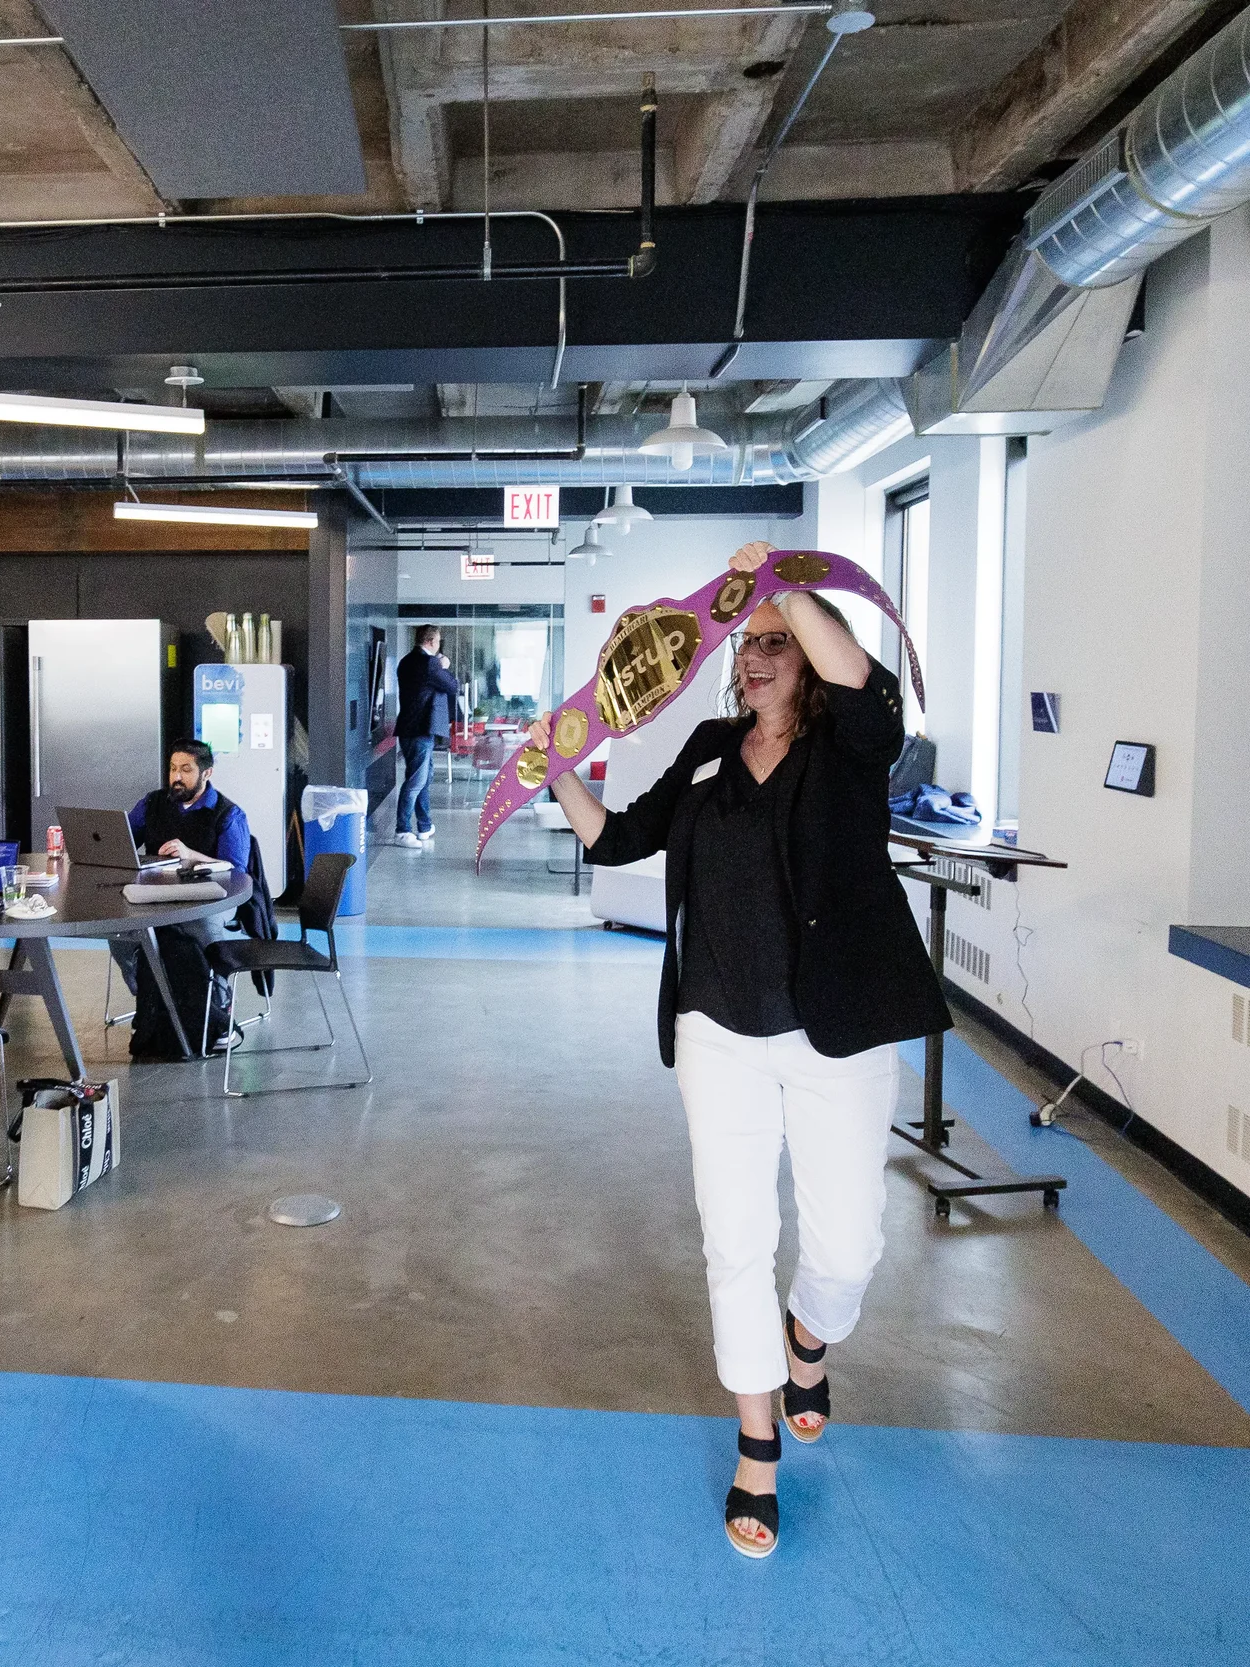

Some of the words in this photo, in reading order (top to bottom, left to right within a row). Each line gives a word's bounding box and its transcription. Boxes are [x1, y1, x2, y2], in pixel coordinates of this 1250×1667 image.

[511, 494, 552, 520] EXIT
[465, 558, 490, 574] EXIT
[202, 674, 239, 690] bevi
[81, 1113, 93, 1150] Chloé
